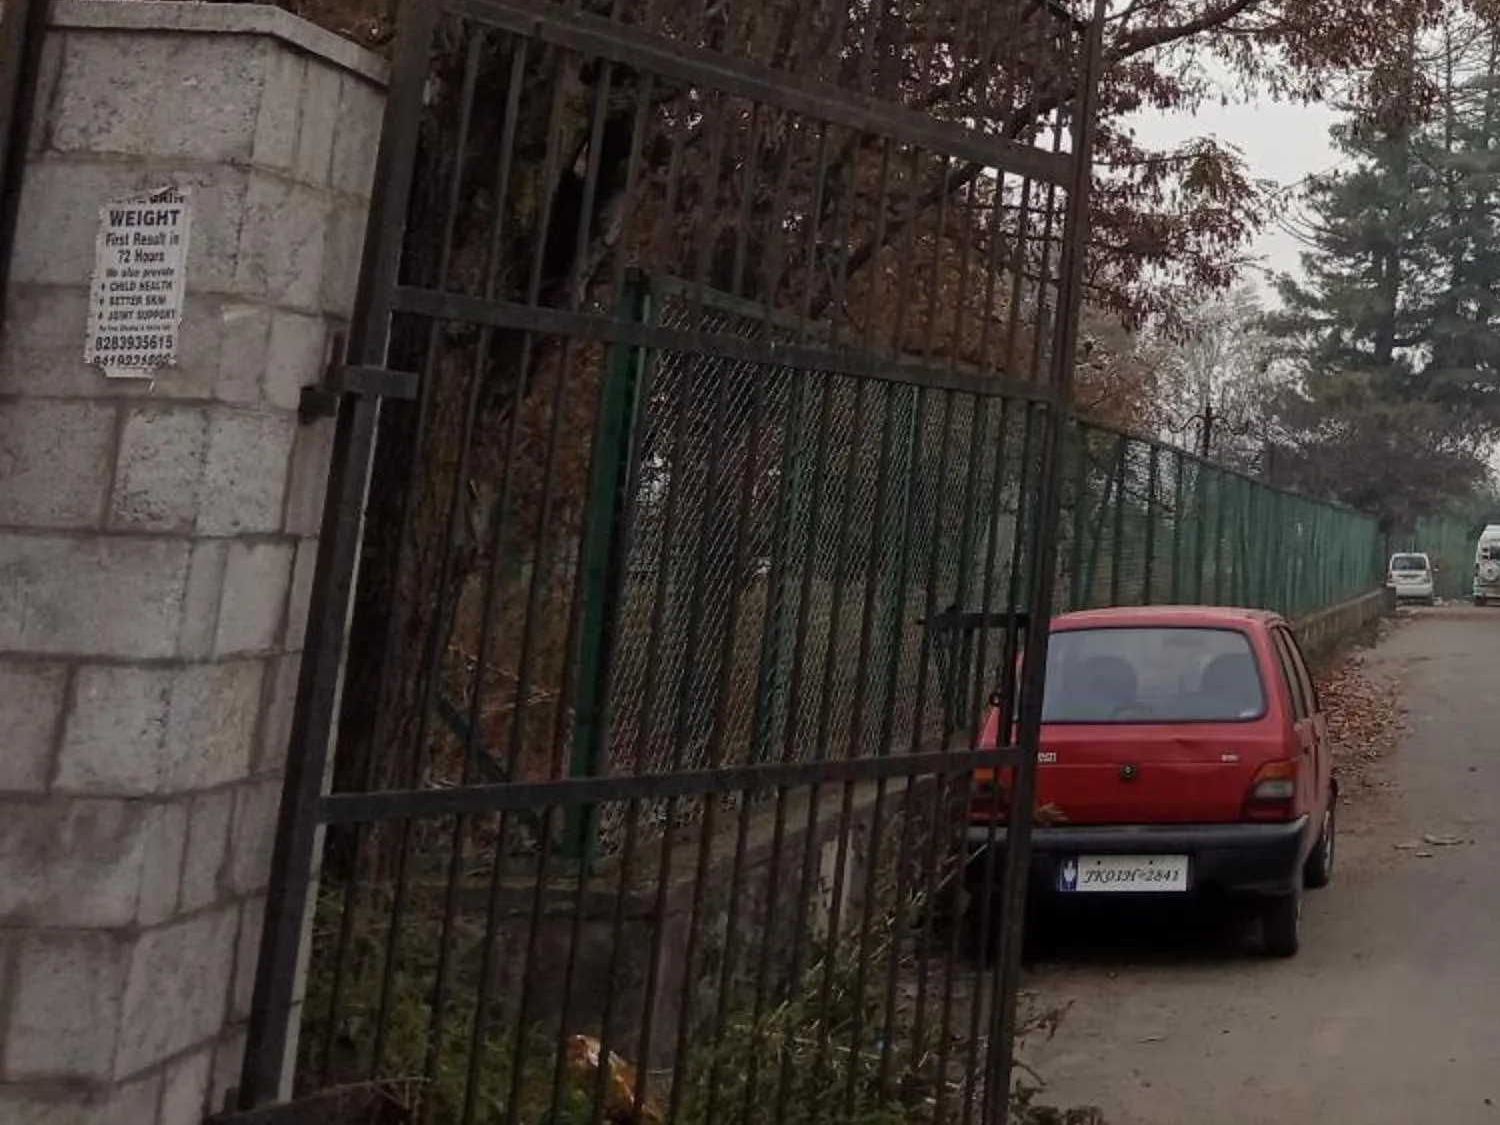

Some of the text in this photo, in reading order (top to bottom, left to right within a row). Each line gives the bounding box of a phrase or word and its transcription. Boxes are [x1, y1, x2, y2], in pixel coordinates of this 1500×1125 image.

[109, 208, 180, 227] WEIGHT
[106, 232, 129, 247] First
[133, 231, 166, 246] Result
[118, 248, 165, 264] 72 Hours
[110, 280, 173, 292] CHILD HEALTH
